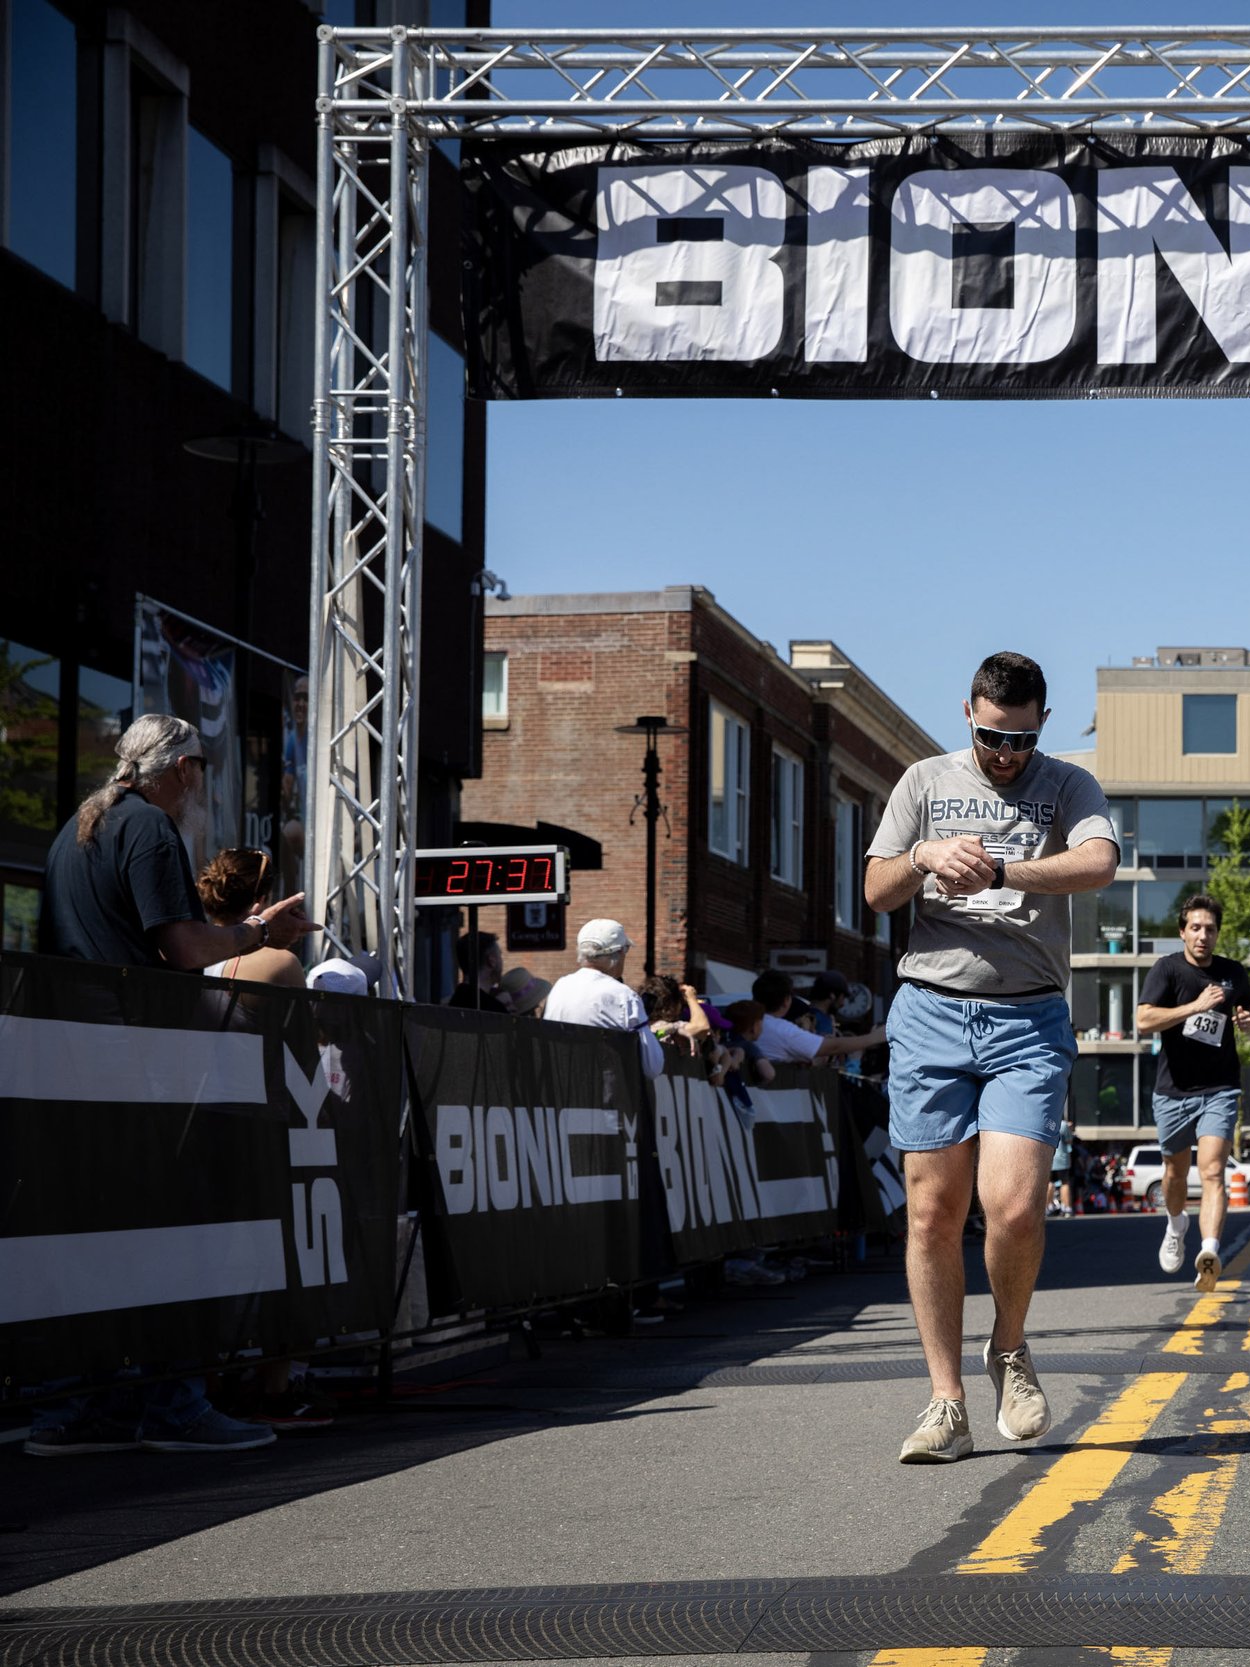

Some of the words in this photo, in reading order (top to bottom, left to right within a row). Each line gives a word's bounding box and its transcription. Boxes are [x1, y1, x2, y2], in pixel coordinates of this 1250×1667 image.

[930, 798, 1056, 826] BRANDEIS
[946, 832, 998, 843] JUES
[446, 858, 552, 893] 27:37
[1194, 1016, 1219, 1035] 433
[436, 1104, 622, 1215] BIONIC
